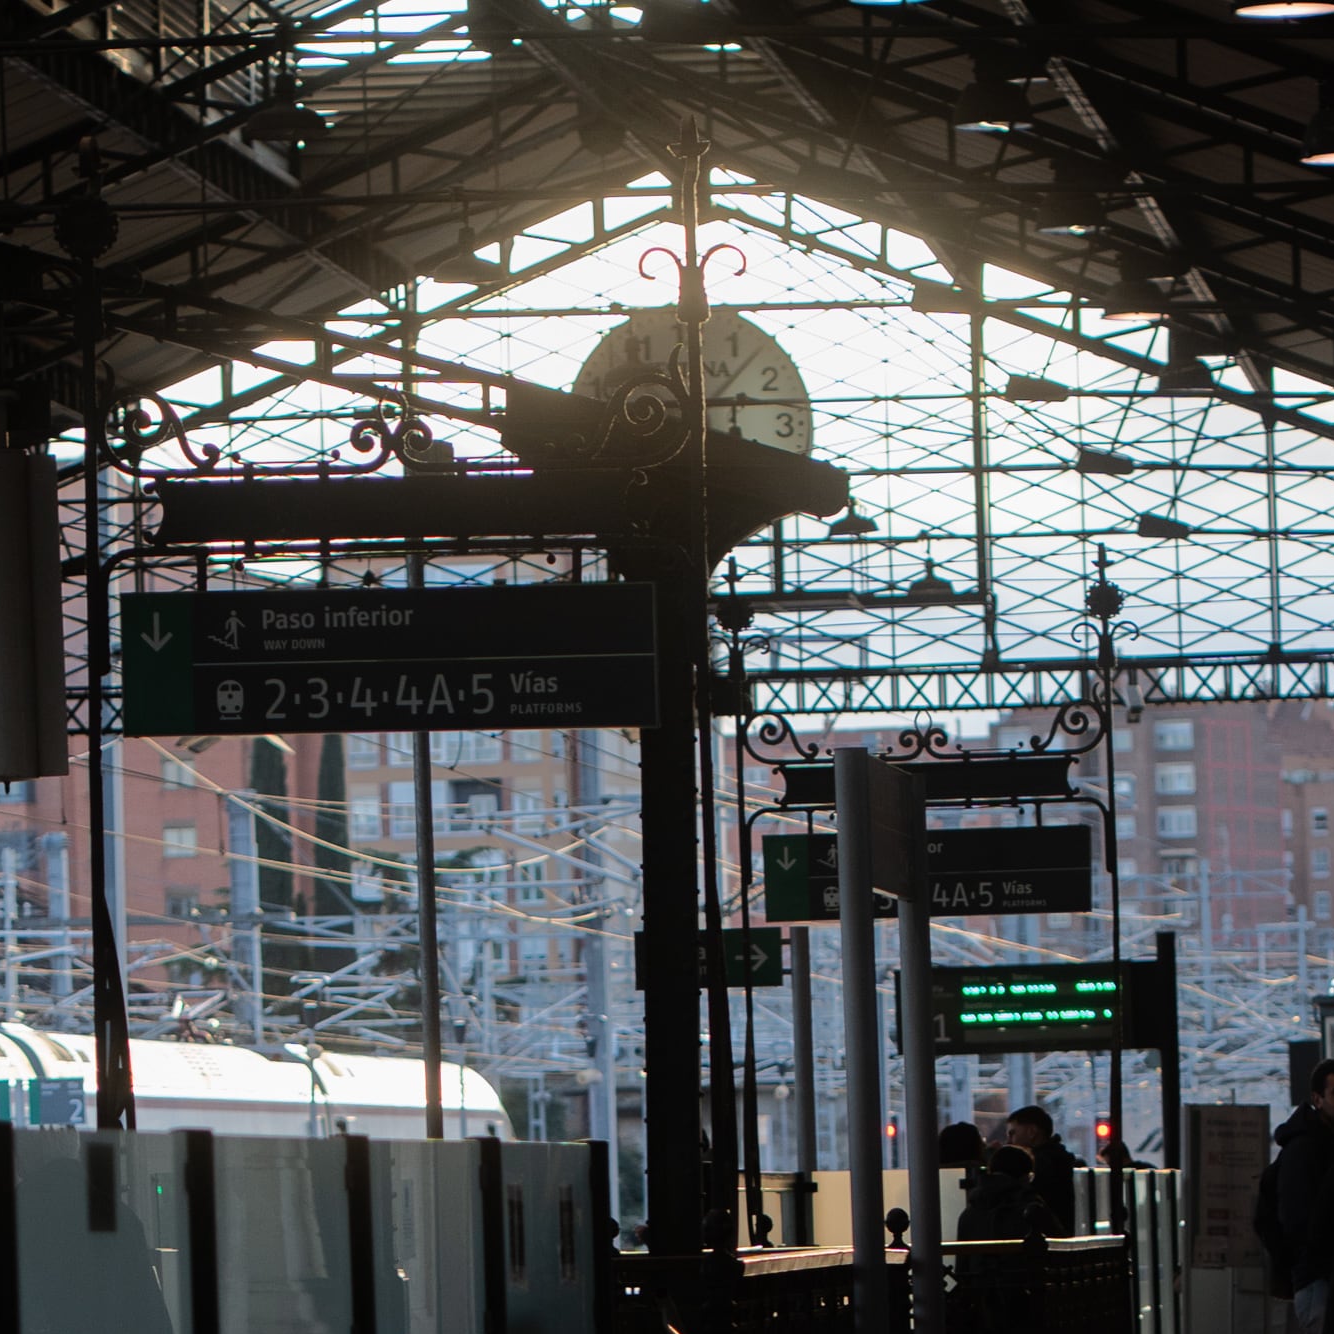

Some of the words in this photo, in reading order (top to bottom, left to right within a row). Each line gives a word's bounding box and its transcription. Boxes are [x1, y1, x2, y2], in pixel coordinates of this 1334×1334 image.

[761, 366, 779, 392] 2
[775, 413, 795, 438] 3
[261, 608, 316, 631] Paso
[323, 603, 414, 629] inferior
[263, 639, 288, 651] WAY
[291, 638, 326, 650] DOWN
[509, 670, 559, 695] Vías
[509, 701, 583, 715] PLATFORMS
[932, 1012, 952, 1043] 1
[69, 1098, 84, 1123] 2
